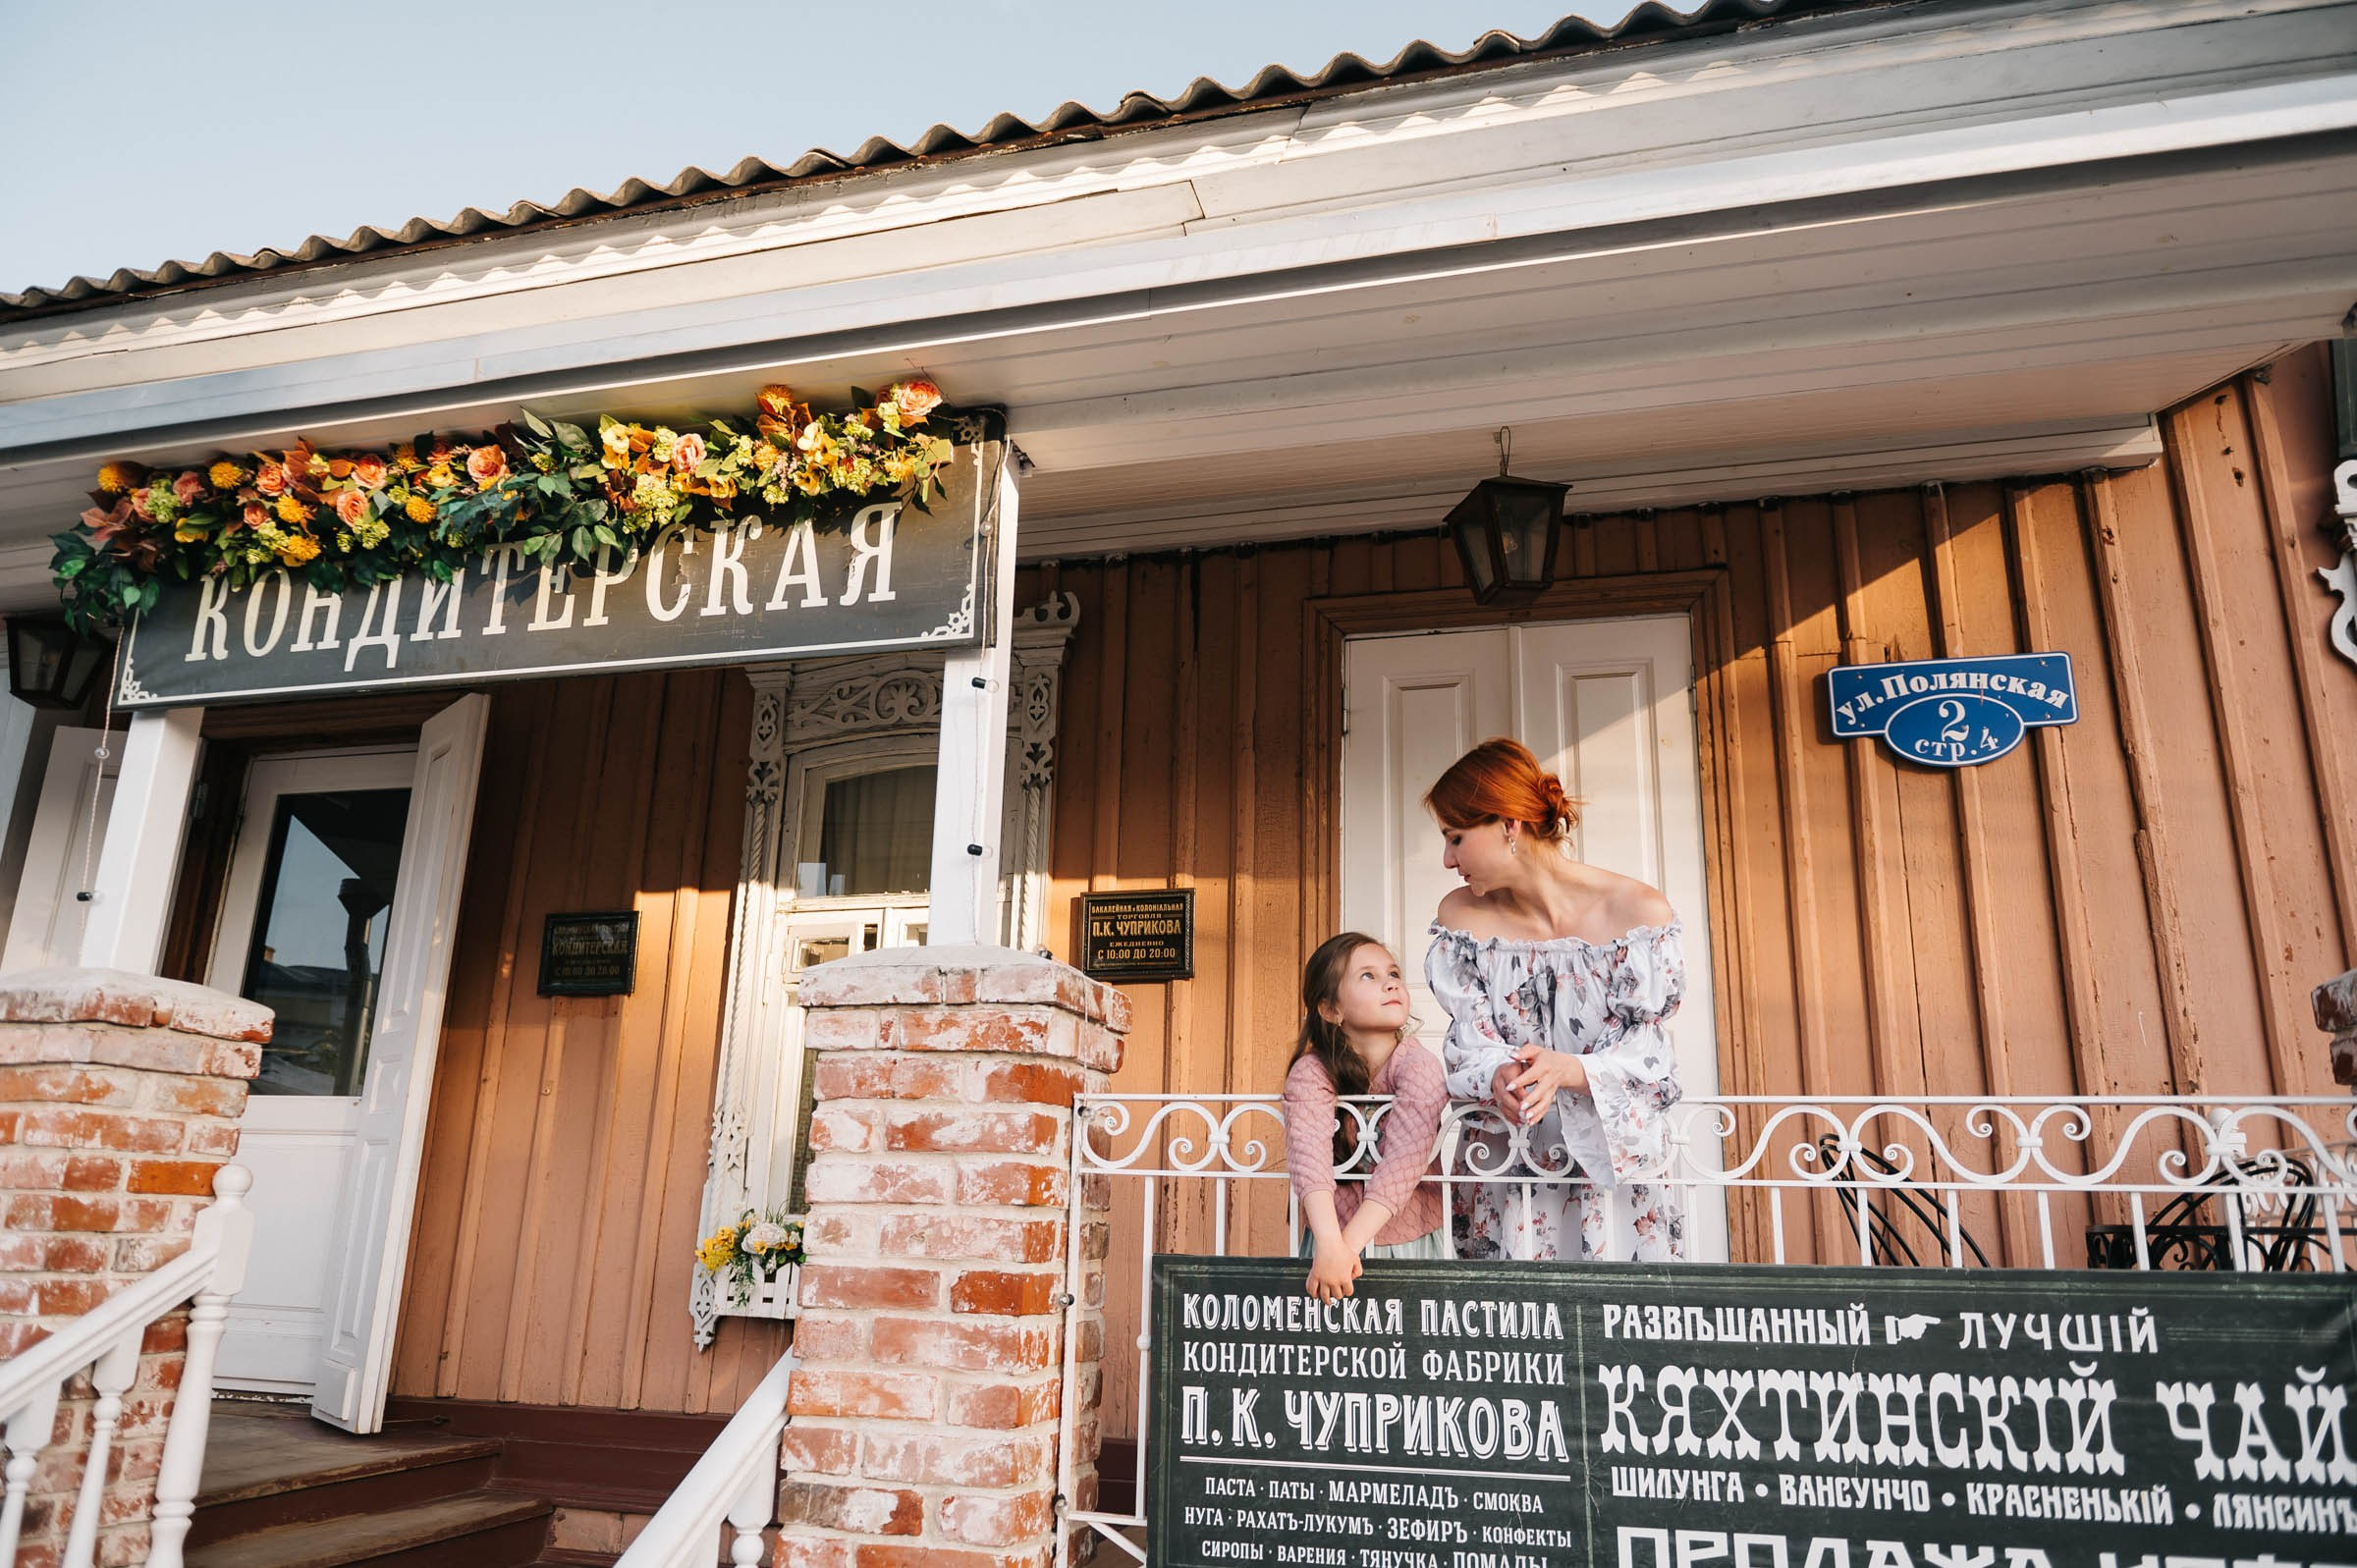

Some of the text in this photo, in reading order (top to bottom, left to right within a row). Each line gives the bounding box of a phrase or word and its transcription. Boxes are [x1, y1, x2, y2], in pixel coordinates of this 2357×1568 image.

[184, 501, 903, 672] КОНДИТЕРСКАЯ
[1939, 699, 1970, 742] 2
[1117, 920, 1180, 936] ЧУПРИКОВА
[1098, 948, 1175, 959] С 10:00 ДО 20:00
[1182, 1293, 1564, 1340] КОЛОМЕНСКАЯ ПАСТИЛА
[1182, 1340, 1565, 1385] КОНДИТЕРСКОЙ ФАБРИКИ
[1283, 1389, 1570, 1463] ЧУПРИКОВА
[2156, 1366, 2357, 1486] ЧАЙ
[1204, 1477, 1544, 1514] ПАСТА ПАТЫ МАРМЕЛАДЪ СМОКВА
[1611, 1466, 1745, 1503] ШИЛУНГА
[1184, 1506, 1572, 1548] НУГА РАХАТЪ-ЛУКУМЪ ЗЕФИРЪ КОНФЕКТЫ
[1201, 1540, 1264, 1560] СИРОПЫ
[1277, 1544, 1346, 1566] ВАРЕНИЯ
[1359, 1548, 1439, 1568] ТЯНУЧКА
